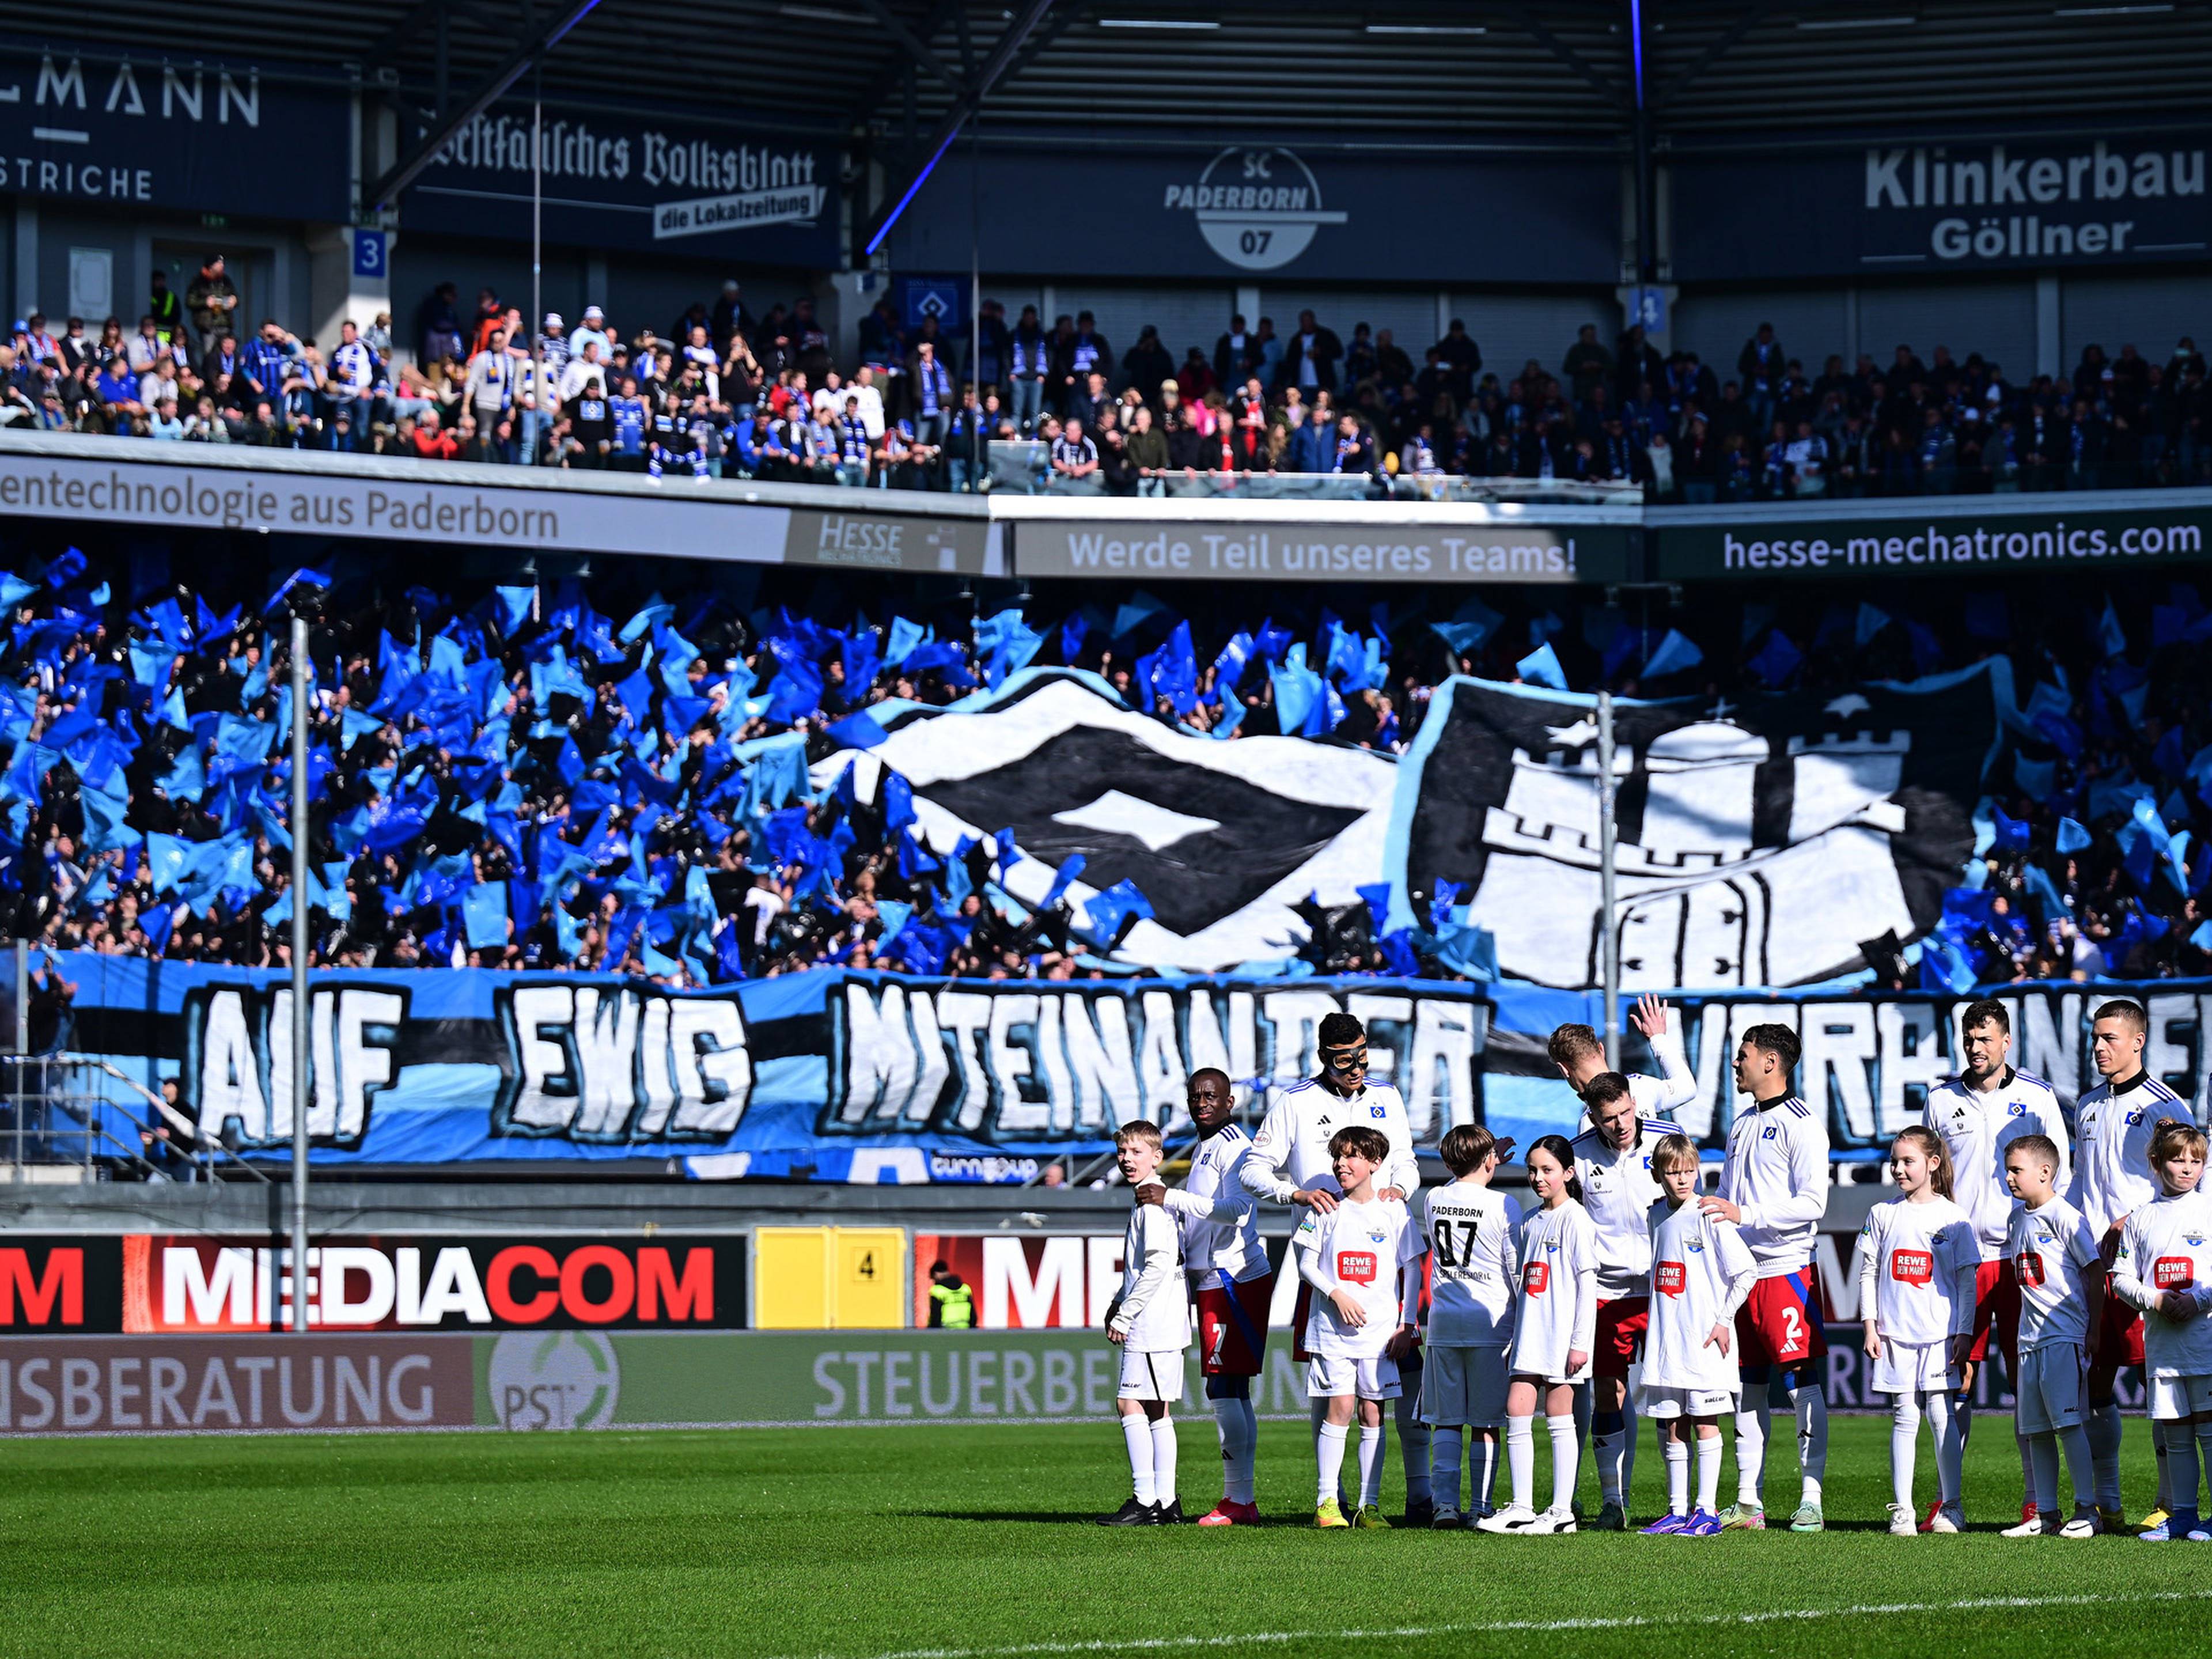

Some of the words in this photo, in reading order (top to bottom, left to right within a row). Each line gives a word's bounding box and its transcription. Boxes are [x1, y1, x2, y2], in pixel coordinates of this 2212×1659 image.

[0, 55, 259, 127] MANN
[1244, 153, 1271, 179] SC
[1865, 142, 2206, 207] Klinkerbau
[661, 206, 688, 230] die
[694, 191, 811, 226] Lokalzeitung
[1165, 185, 1309, 210] PADERBORN
[1241, 230, 1272, 254] 07
[1931, 215, 2134, 259] Göllner
[362, 241, 379, 269] 3
[1, 471, 278, 529] entechnologie
[290, 497, 353, 525] aus
[368, 491, 560, 538] Paderborn
[819, 514, 903, 552] HESSE
[1724, 522, 2202, 568] hesse-mechatronics.com
[1067, 533, 1192, 569] Werde
[1201, 535, 1270, 569] Teil
[1283, 539, 1430, 573] unseres
[1442, 537, 1575, 574] Teams!
[199, 988, 402, 1139] AUF
[513, 984, 750, 1134] EWIG
[1431, 1206, 1483, 1218] PADERBORN
[1434, 1219, 1478, 1268] 07
[857, 1251, 874, 1275] 4
[1343, 1257, 1372, 1266] REWE
[1897, 1256, 1927, 1266] REWE
[2158, 1263, 2187, 1272] REWE
[162, 1245, 714, 1325] MEDIACOM
[1213, 1323, 1227, 1353] 7
[1782, 1306, 1803, 1338] 2
[1704, 1396, 1726, 1404] saller
